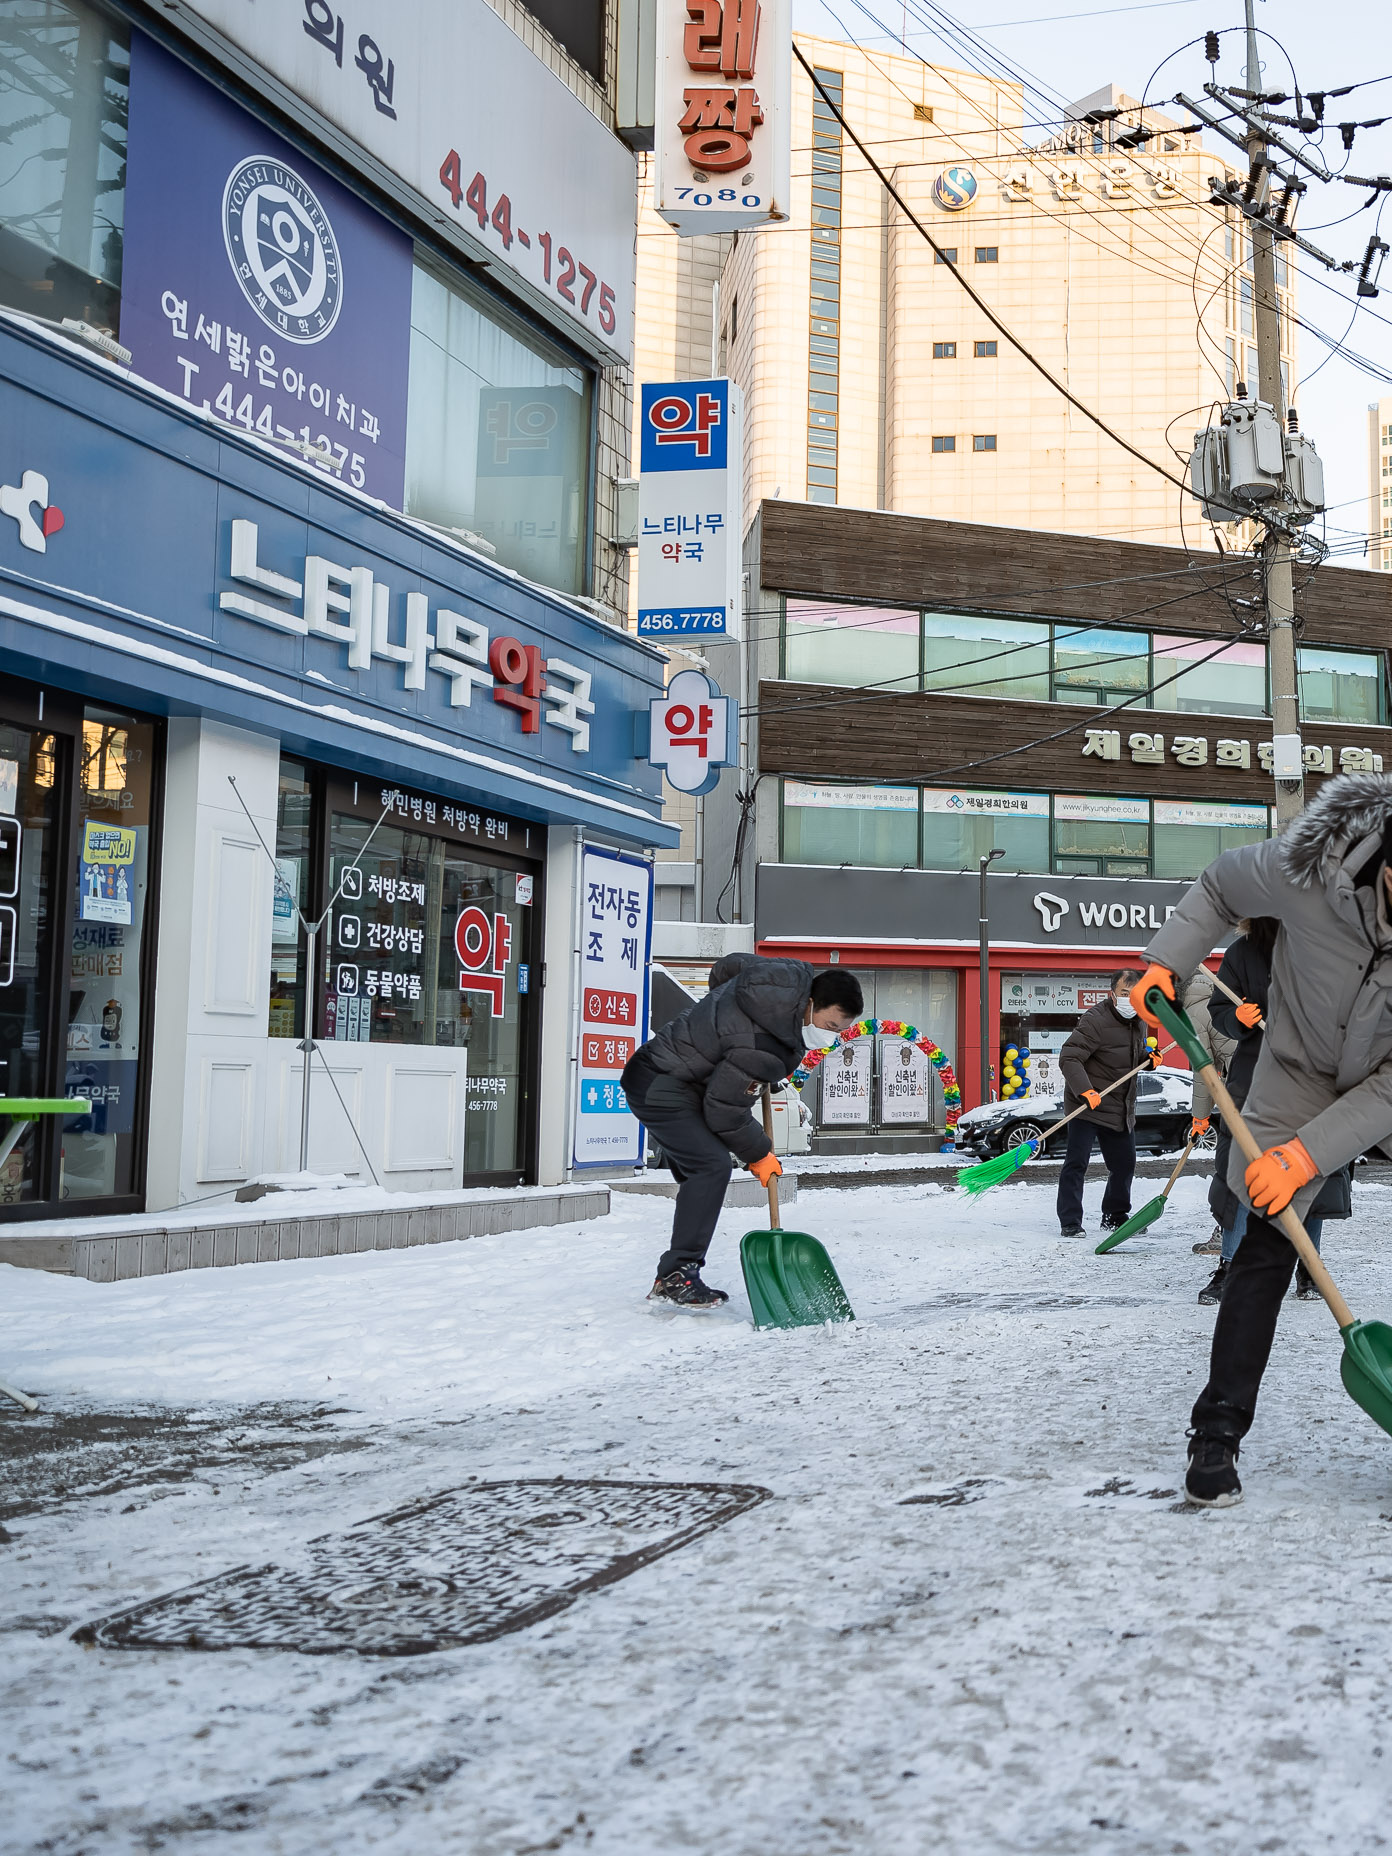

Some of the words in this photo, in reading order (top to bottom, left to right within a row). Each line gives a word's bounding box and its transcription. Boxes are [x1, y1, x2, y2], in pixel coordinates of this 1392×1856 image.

[303, 0, 397, 120] 의원
[674, 188, 761, 208] 7080
[230, 166, 269, 217] YONSEI
[273, 169, 338, 285] UNIVERSITY
[440, 149, 616, 336] 444-1275
[239, 262, 327, 335] 연세대학교
[275, 284, 292, 300] 1885
[161, 290, 381, 444] 연세밝은아이치과
[649, 392, 721, 457] 약
[641, 513, 724, 536] 느티나무
[661, 542, 704, 563] 약국
[640, 612, 723, 630] 456.7778
[219, 518, 595, 753] 느티나무약국
[664, 703, 712, 758] 약
[966, 798, 1028, 809] 제일경희한의원
[1063, 802, 1141, 814] www.jikyunghee.co.kr
[442, 805, 480, 836] 처방약
[485, 817, 508, 841] 완비
[109, 839, 131, 859] NO!
[368, 874, 425, 906] 처방조제
[587, 881, 641, 929] 전자동
[366, 922, 424, 954] 건강상담
[454, 905, 512, 1019] 약
[364, 970, 422, 1000] 동물약품
[605, 990, 630, 1014] 신속
[1008, 999, 1027, 1007] 인터넷
[1037, 999, 1047, 1007] TV
[1056, 999, 1075, 1007] CCTV
[603, 1039, 628, 1065] 정확
[836, 1069, 859, 1084] 신축년
[895, 1069, 917, 1084] 신축년
[1035, 1081, 1055, 1095] 신축년
[829, 1084, 865, 1098] 할인이왔소
[888, 1084, 924, 1098] 할인이왔소
[468, 1101, 498, 1111] 456-7778
